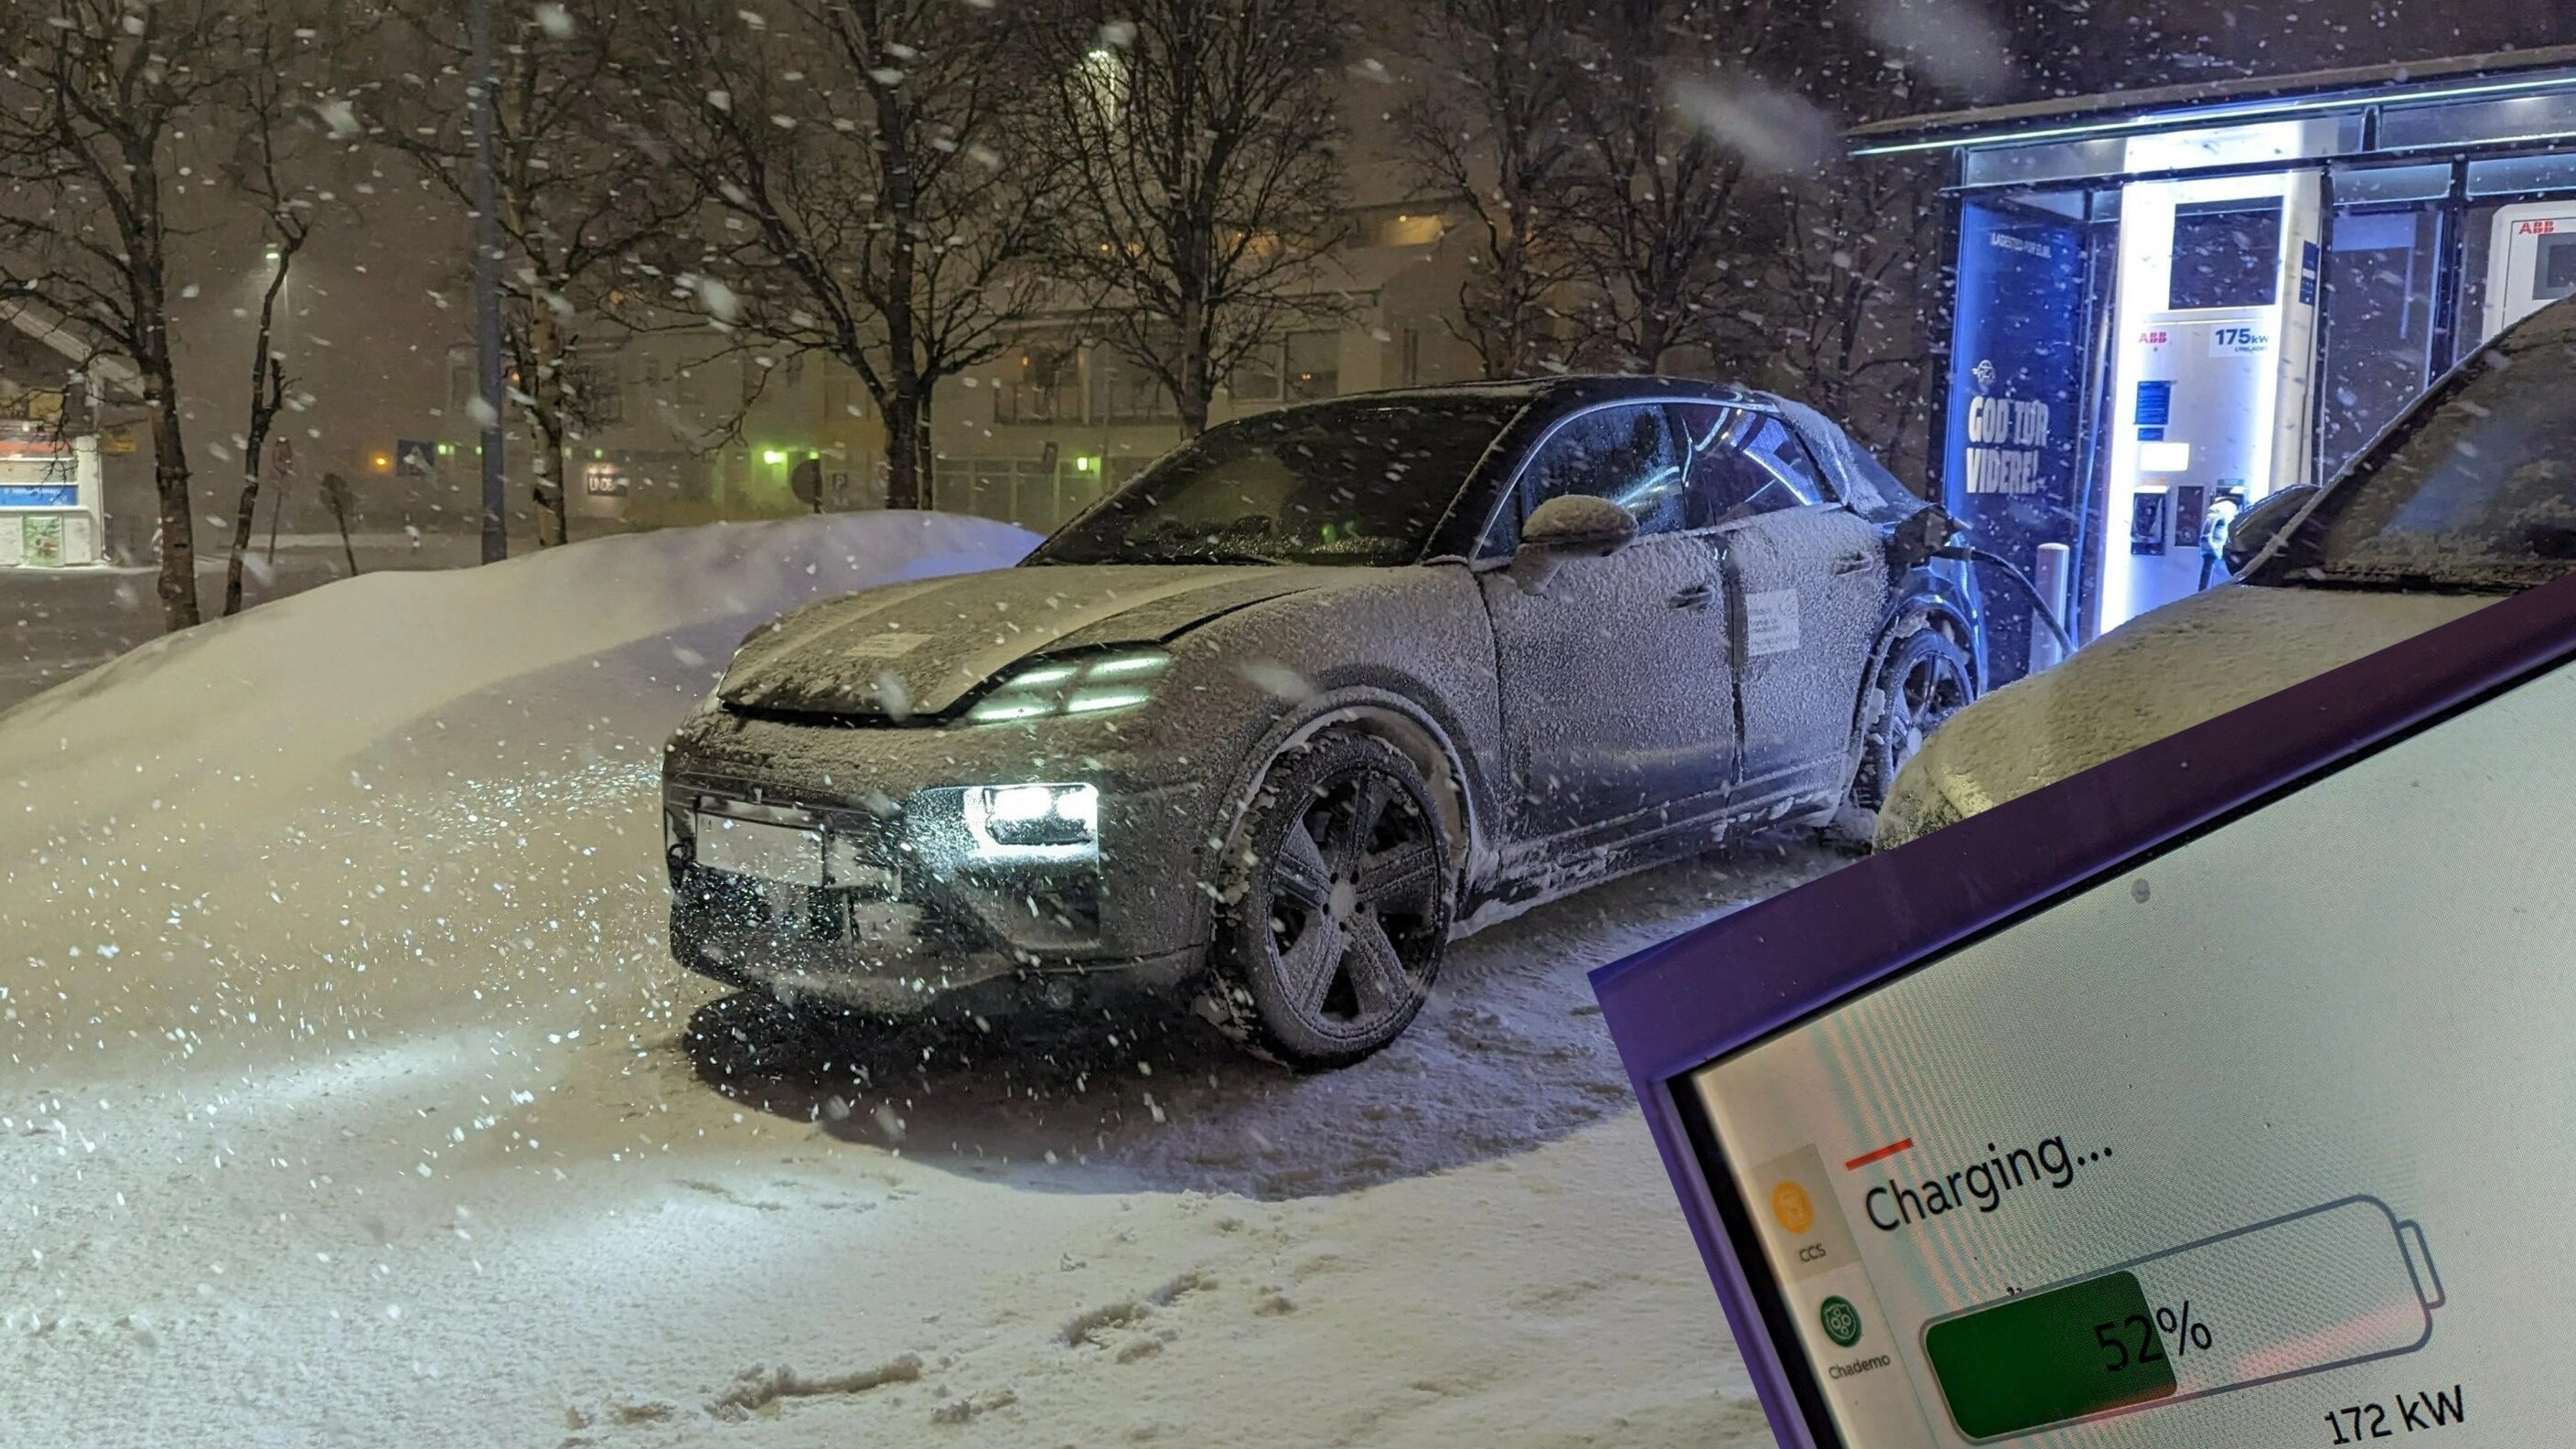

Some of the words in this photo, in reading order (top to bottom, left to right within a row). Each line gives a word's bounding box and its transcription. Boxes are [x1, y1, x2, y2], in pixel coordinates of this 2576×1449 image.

[2518, 220, 2554, 234] ABB
[2139, 331, 2167, 344] ABB
[2215, 327, 2251, 346] 175
[2250, 335, 2270, 344] kW
[1969, 395, 2010, 444] GOD
[2013, 400, 2049, 446] TUR
[1966, 447, 2039, 495] VIDERE!
[1865, 1135, 2113, 1231] Charging...
[1799, 1243, 1827, 1262] CCS
[2094, 1300, 2213, 1371] 52%
[1830, 1354, 1891, 1379] Chademo
[2324, 1402, 2393, 1445] 172
[2395, 1384, 2464, 1432] kW
